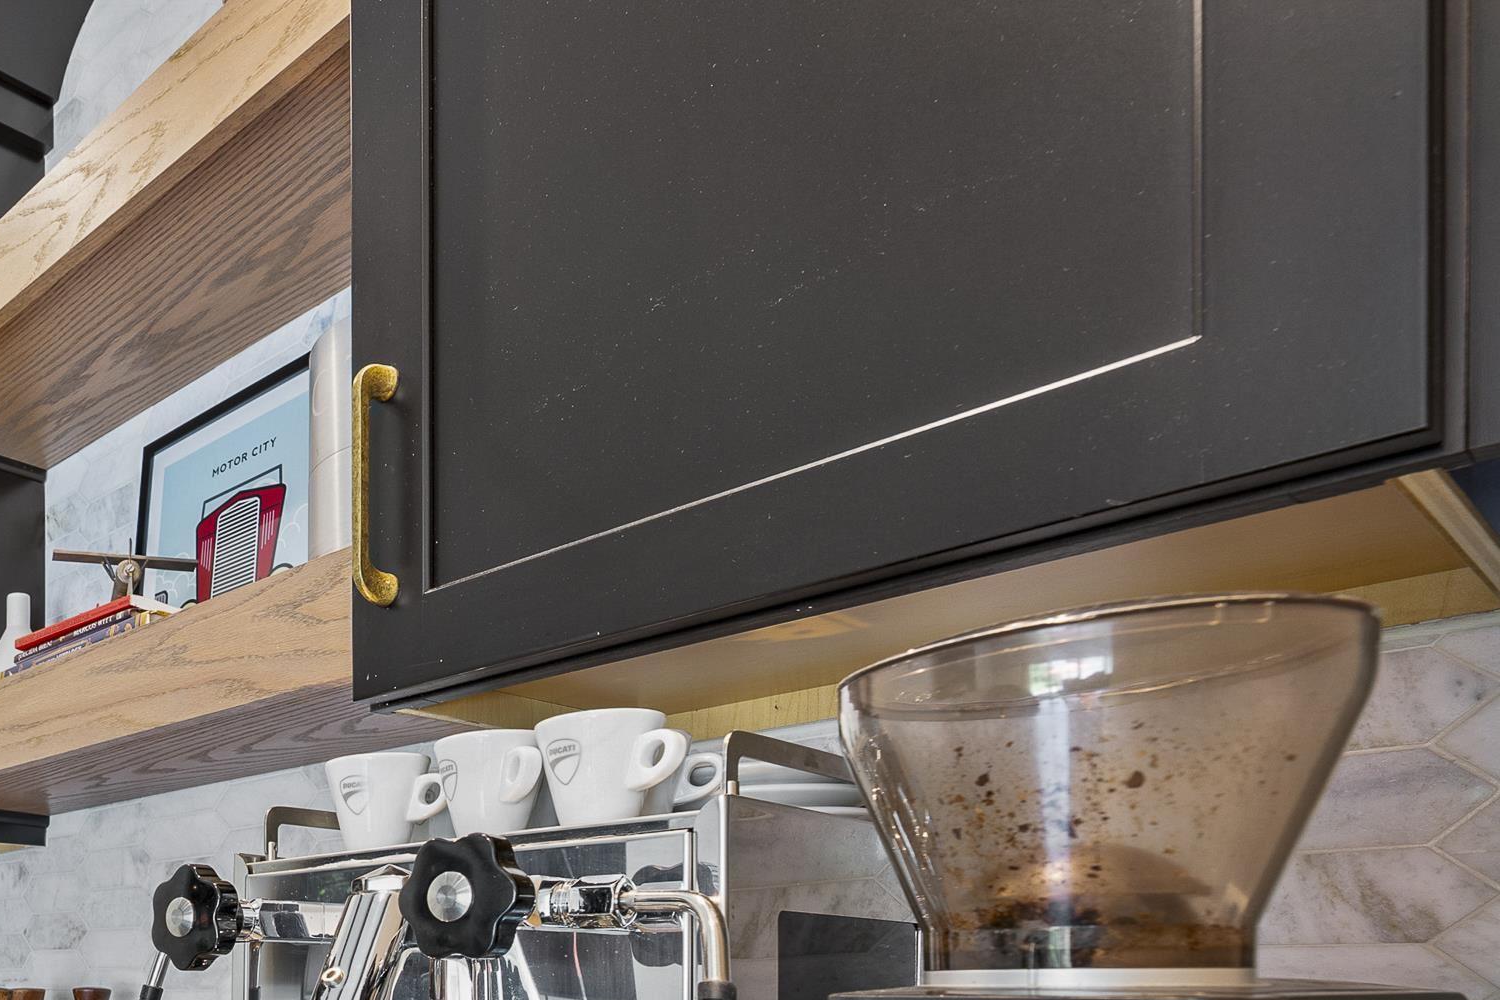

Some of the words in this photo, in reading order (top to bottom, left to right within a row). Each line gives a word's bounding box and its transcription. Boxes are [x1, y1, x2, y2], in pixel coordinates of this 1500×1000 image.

[212, 452, 248, 478] MOTOR
[251, 436, 277, 457] CITY
[549, 744, 576, 756] DUCATI
